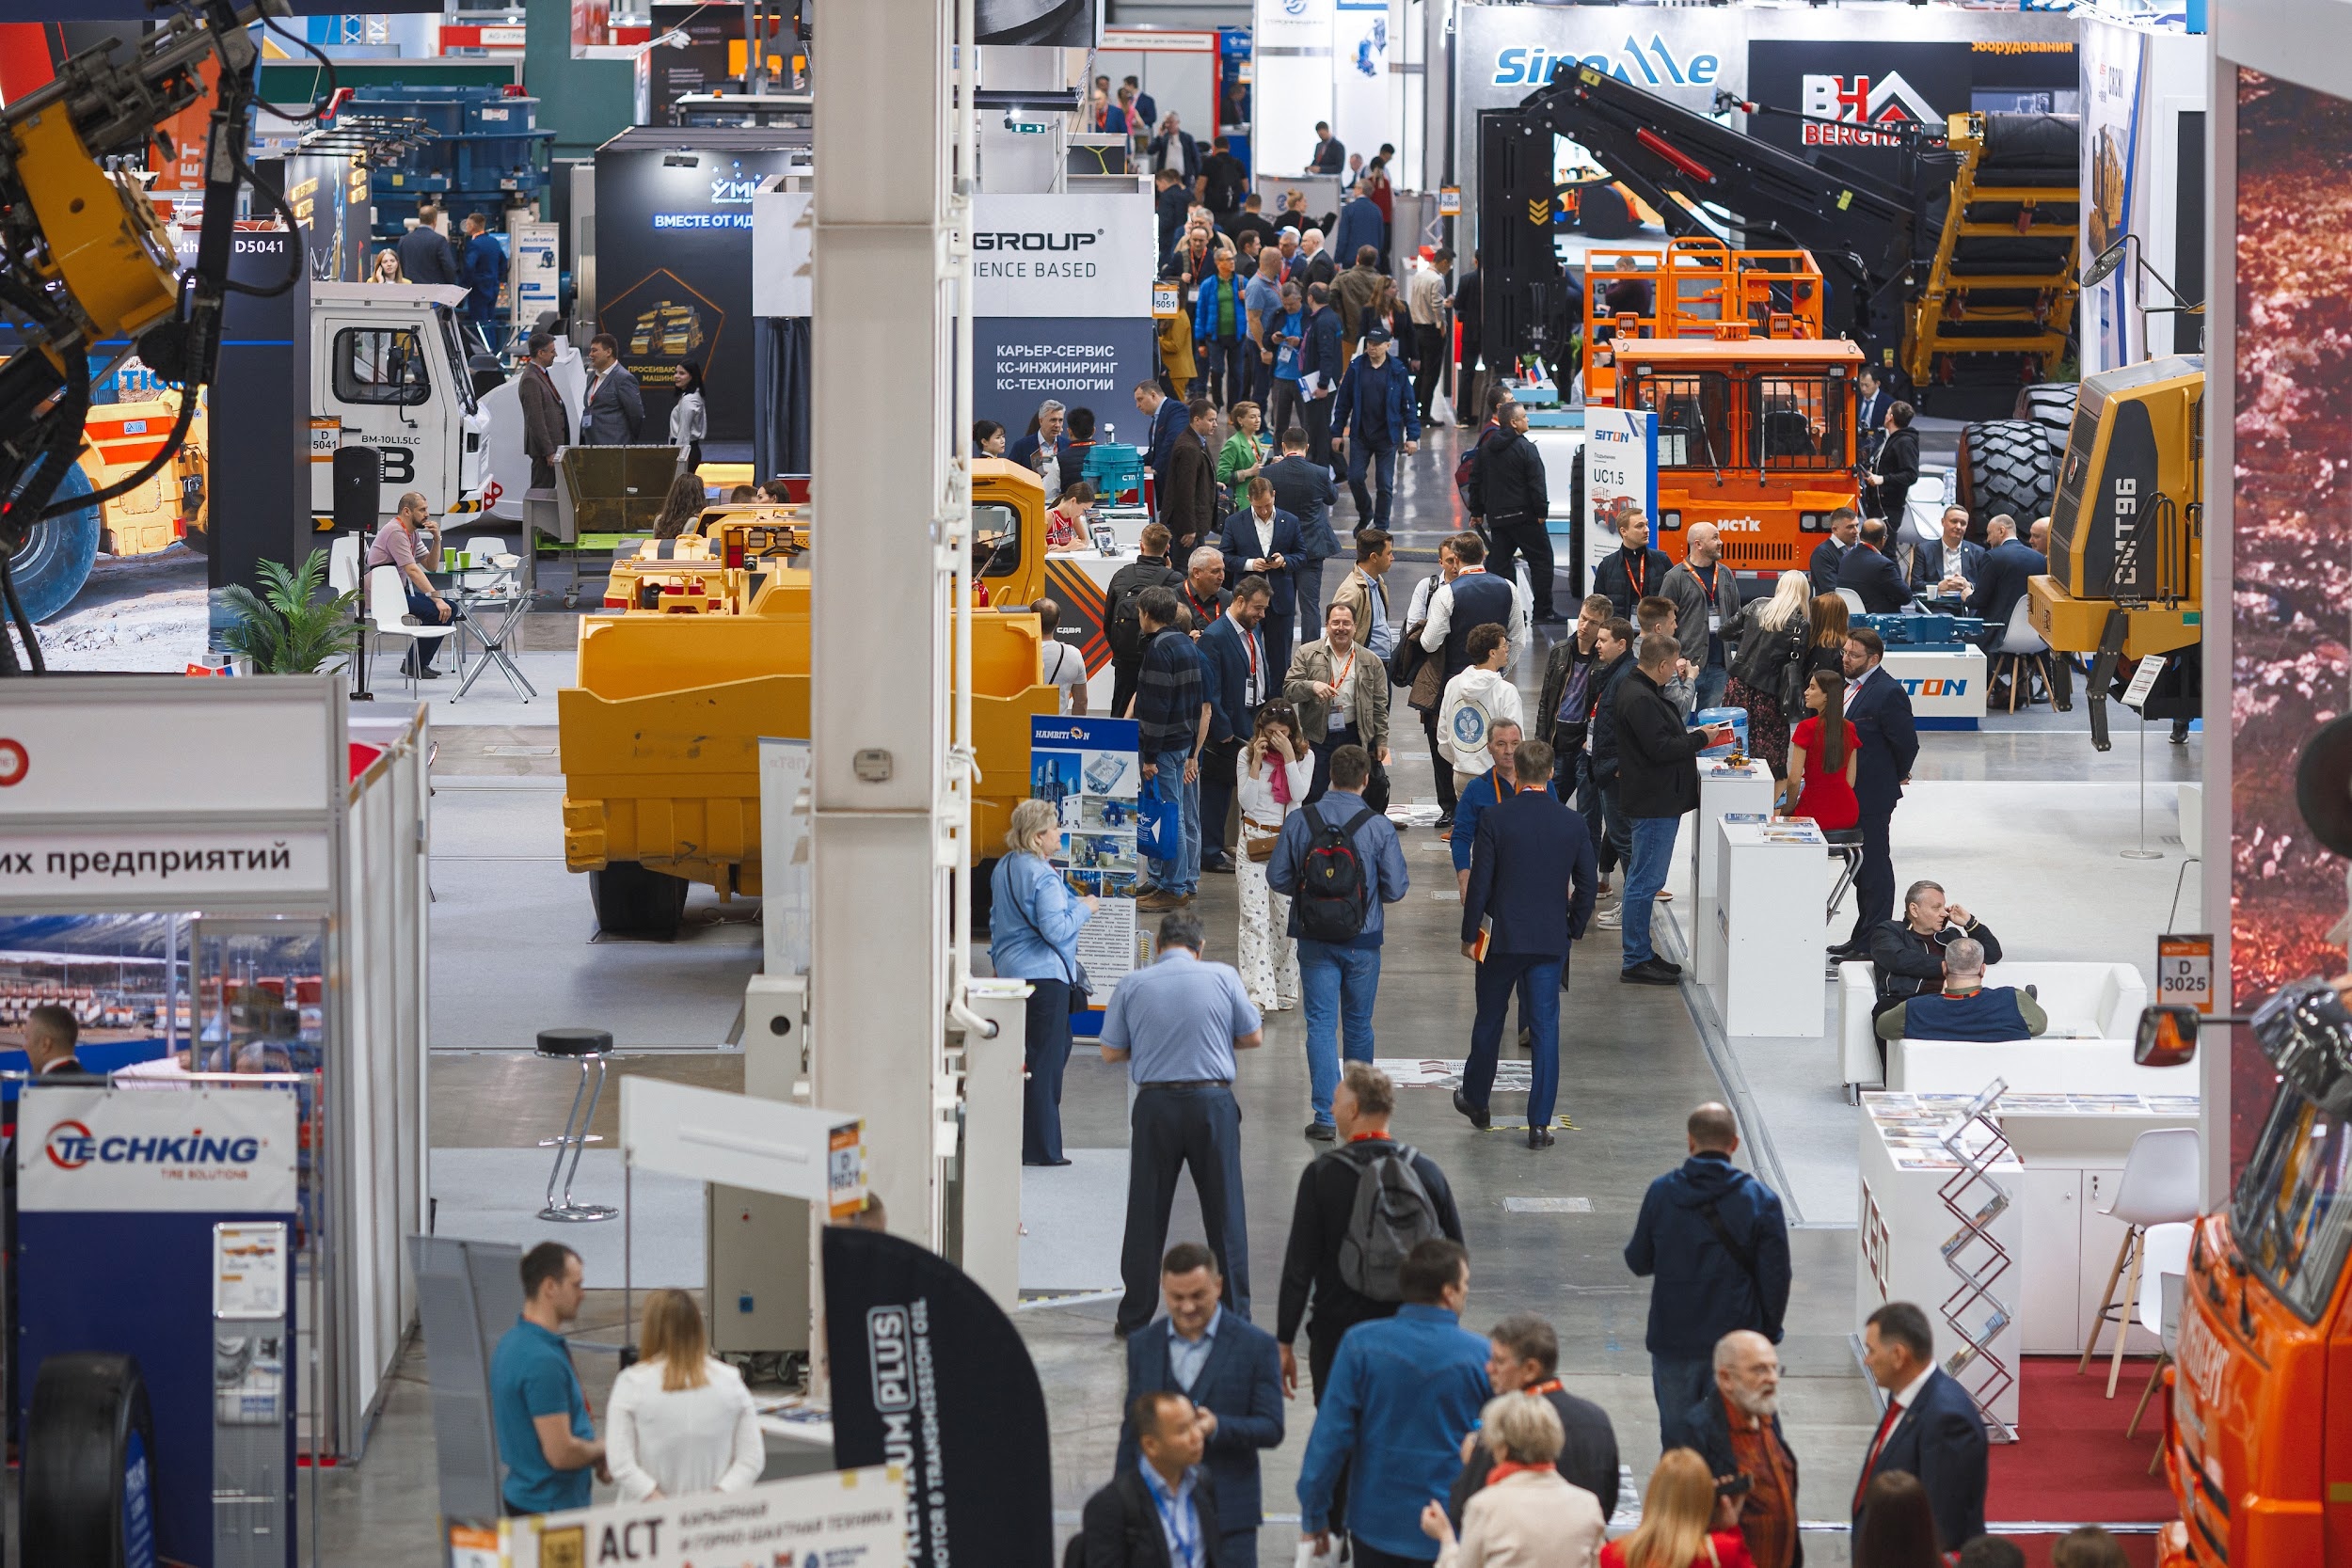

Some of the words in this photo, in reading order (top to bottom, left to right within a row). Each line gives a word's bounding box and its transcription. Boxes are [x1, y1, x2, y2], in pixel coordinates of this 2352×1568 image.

[1803, 123, 1947, 146] BERGH
[655, 214, 710, 228] ВМЕСТЕ
[712, 214, 731, 228] ОТ
[235, 240, 283, 253] D5041
[1035, 262, 1096, 277] BASED
[1162, 293, 1169, 301] D
[1155, 300, 1176, 309] 5051
[996, 344, 1115, 357] КАРЬЕР-СЕРВИС
[996, 361, 1119, 374] КС-ИНЖИНИРИНГ
[996, 378, 1114, 390] КС-ТЕХНОЛОГИИ
[321, 431, 329, 440] D
[361, 435, 421, 445] BM-10L1.5LC
[1595, 429, 1629, 443] SITON
[312, 440, 337, 450] 5041
[1594, 468, 1625, 485] UC1.5
[1896, 679, 1968, 696] TON
[47, 841, 291, 880] предприятий
[2179, 959, 2192, 975] D
[2165, 976, 2206, 992] 3025
[910, 1296, 930, 1335] OIL
[872, 1313, 909, 1405] PLUS
[914, 1335, 945, 1490] TRANSMISSION
